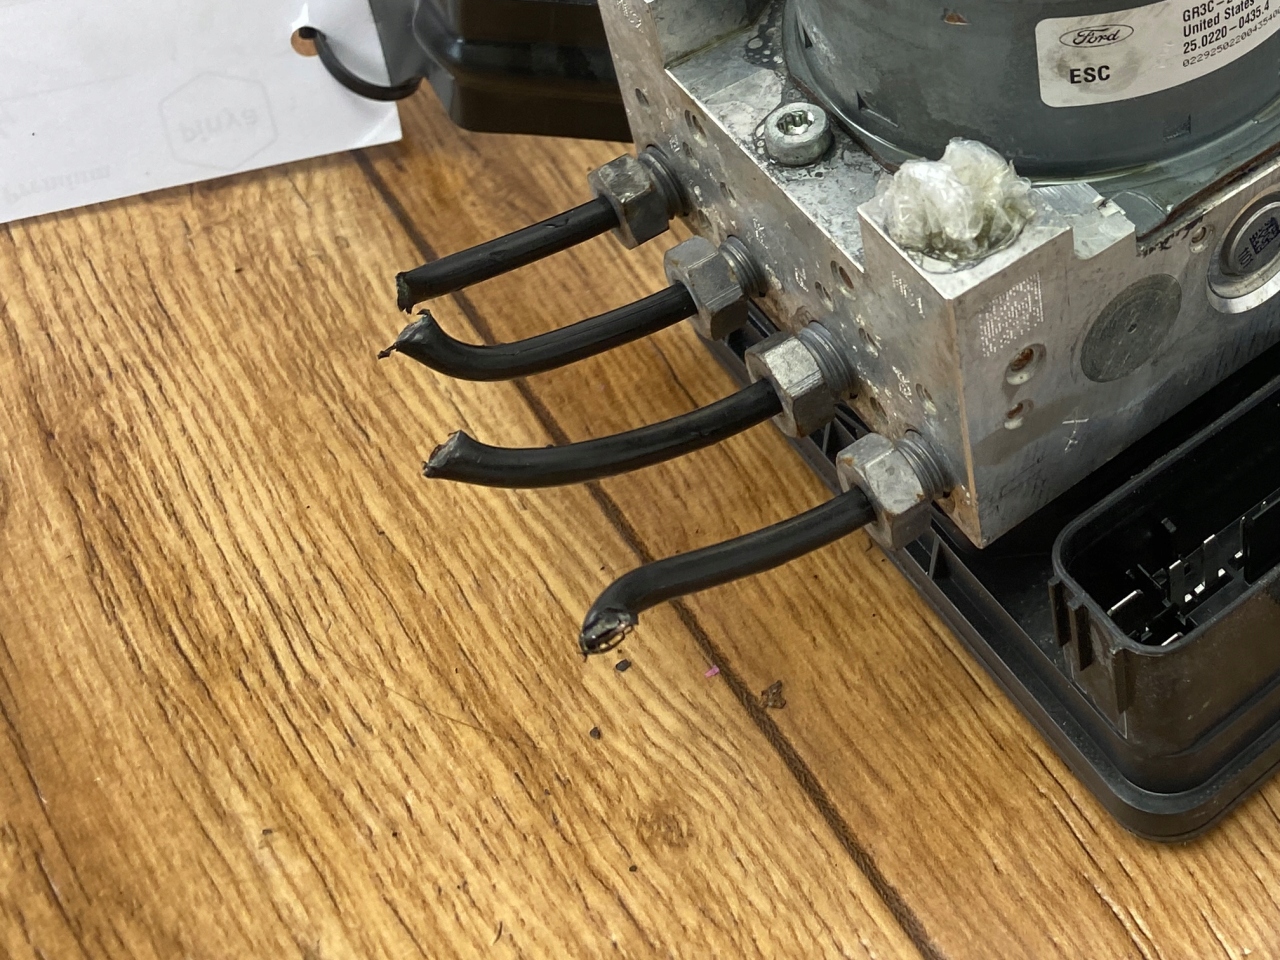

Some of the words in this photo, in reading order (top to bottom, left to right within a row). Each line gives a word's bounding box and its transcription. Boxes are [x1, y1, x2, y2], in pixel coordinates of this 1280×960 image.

[1072, 27, 1121, 45] Ford
[1183, 12, 1220, 38] United
[1183, 0, 1270, 55] 25.0220-0435.4
[1069, 64, 1111, 85] ESC
